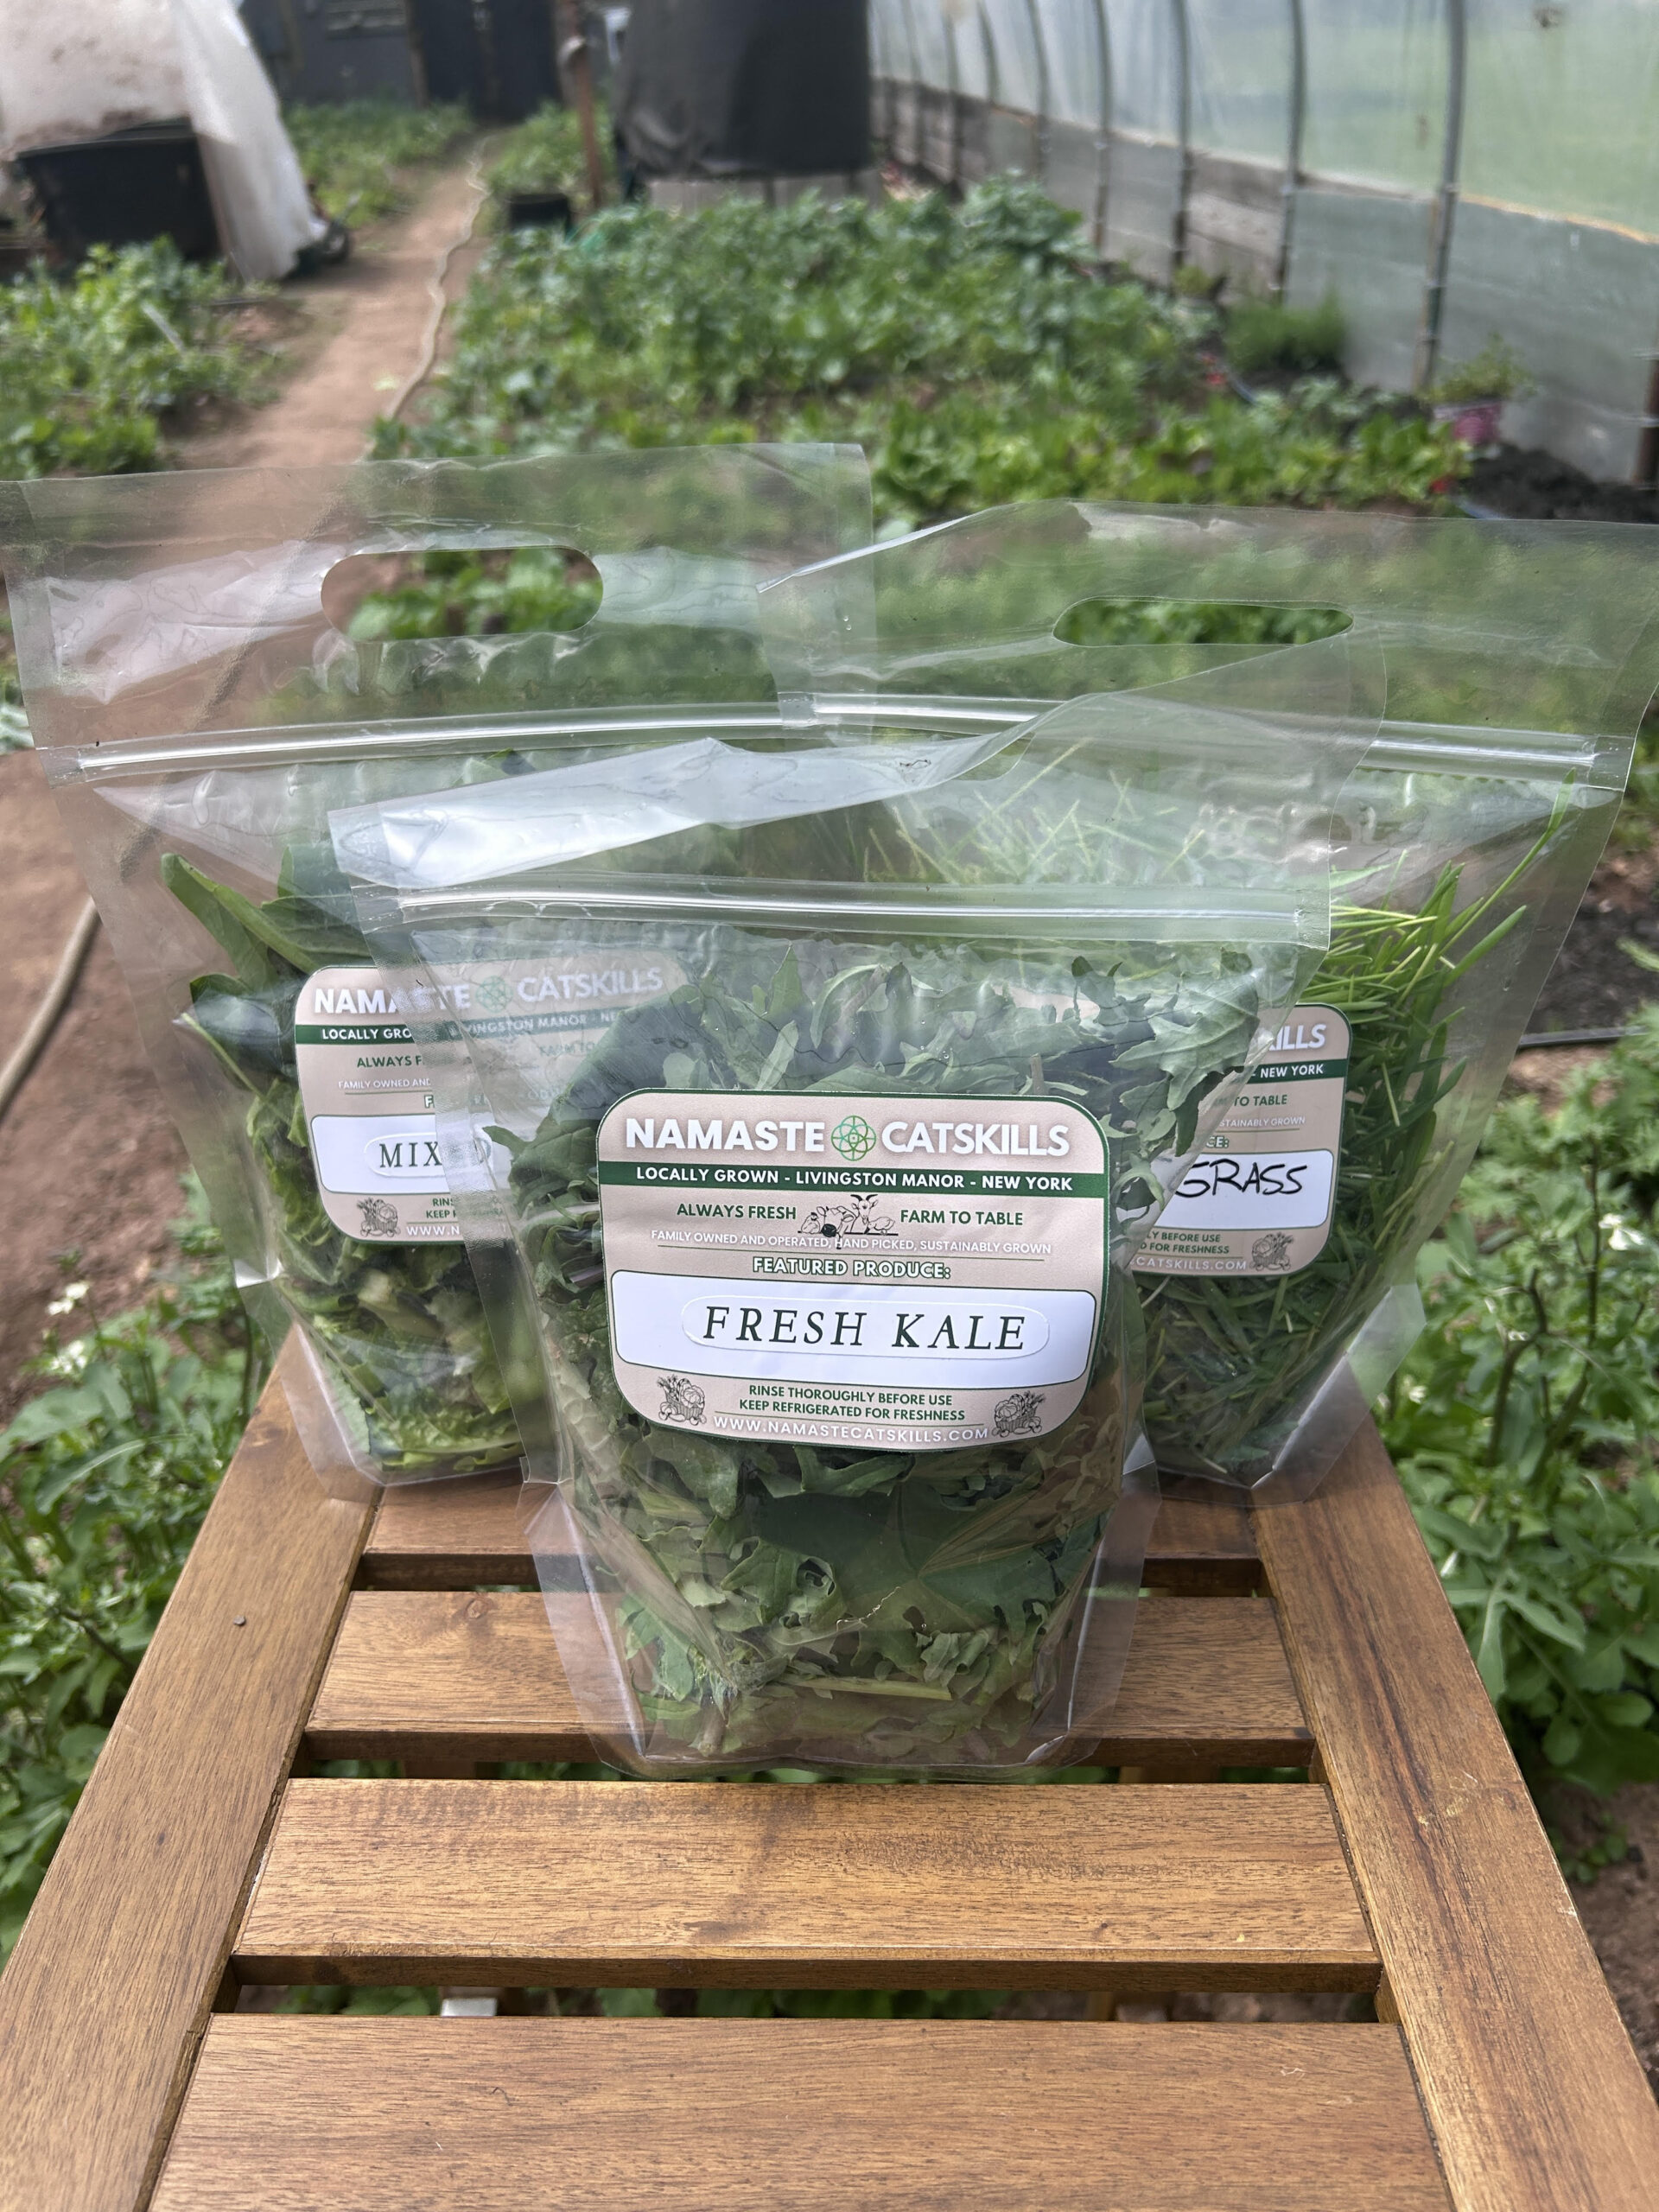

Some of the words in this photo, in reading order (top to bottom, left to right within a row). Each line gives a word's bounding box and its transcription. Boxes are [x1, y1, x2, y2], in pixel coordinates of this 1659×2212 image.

[315, 983, 472, 1014] NAMTE
[518, 967, 663, 1003] CATSKILLS
[322, 1028, 378, 1039] LOCALLY
[538, 1015, 587, 1028] MANOR
[357, 1056, 411, 1068] ALWAYS
[1261, 1066, 1287, 1078] NEW
[1292, 1064, 1324, 1076] YORK
[373, 1079, 410, 1088] OWNED
[1253, 1095, 1287, 1106] TABLE
[1219, 1118, 1269, 1127] STAINABLY
[1271, 1116, 1306, 1125] GROWN
[626, 1118, 825, 1152] NAMASTE
[881, 1122, 1070, 1157] CATSKILLS
[637, 1166, 709, 1182] LOCALLY
[715, 1168, 779, 1184] GROWN
[796, 1171, 897, 1186] LIVINGSTON
[902, 1173, 964, 1188] MANOR
[982, 1175, 1020, 1189] NEW
[1026, 1176, 1072, 1191] YORK
[426, 1210, 450, 1218] KEEP
[677, 1204, 744, 1218] ALWAYS
[749, 1205, 797, 1219] FRESH
[900, 1210, 945, 1224] FARM
[950, 1211, 971, 1224] TO
[976, 1211, 1023, 1225] TABLE
[652, 1230, 691, 1243] FAMILY
[695, 1232, 737, 1244] OWNED
[741, 1235, 764, 1246] AND
[768, 1236, 831, 1249] OPERATED,
[836, 1237, 868, 1249] HAND
[872, 1239, 918, 1251] PICKED,
[920, 1240, 1000, 1253] SUSTAINABLY
[1003, 1243, 1052, 1254] GROWN
[1161, 1232, 1199, 1242] BEFORE
[1202, 1234, 1220, 1243] USE
[1149, 1243, 1170, 1252] FOR
[1173, 1244, 1230, 1254] FRESHNESS
[753, 1256, 847, 1275] FEATURED
[853, 1260, 951, 1279] PRODUCE:
[702, 1306, 867, 1346] FRESH
[892, 1313, 1025, 1350] KALE
[749, 1384, 785, 1397] RINSE
[788, 1387, 875, 1402] THOROUGHLY
[879, 1392, 925, 1406] BEFORE
[929, 1394, 952, 1406] USE
[740, 1399, 769, 1411] KEEP
[773, 1402, 861, 1417] REFRIGERATED
[865, 1407, 890, 1420] FOR
[893, 1408, 965, 1421] FRESHNESS
[714, 1415, 988, 1443] WWW.NAMASTECATSKILLS.COM
